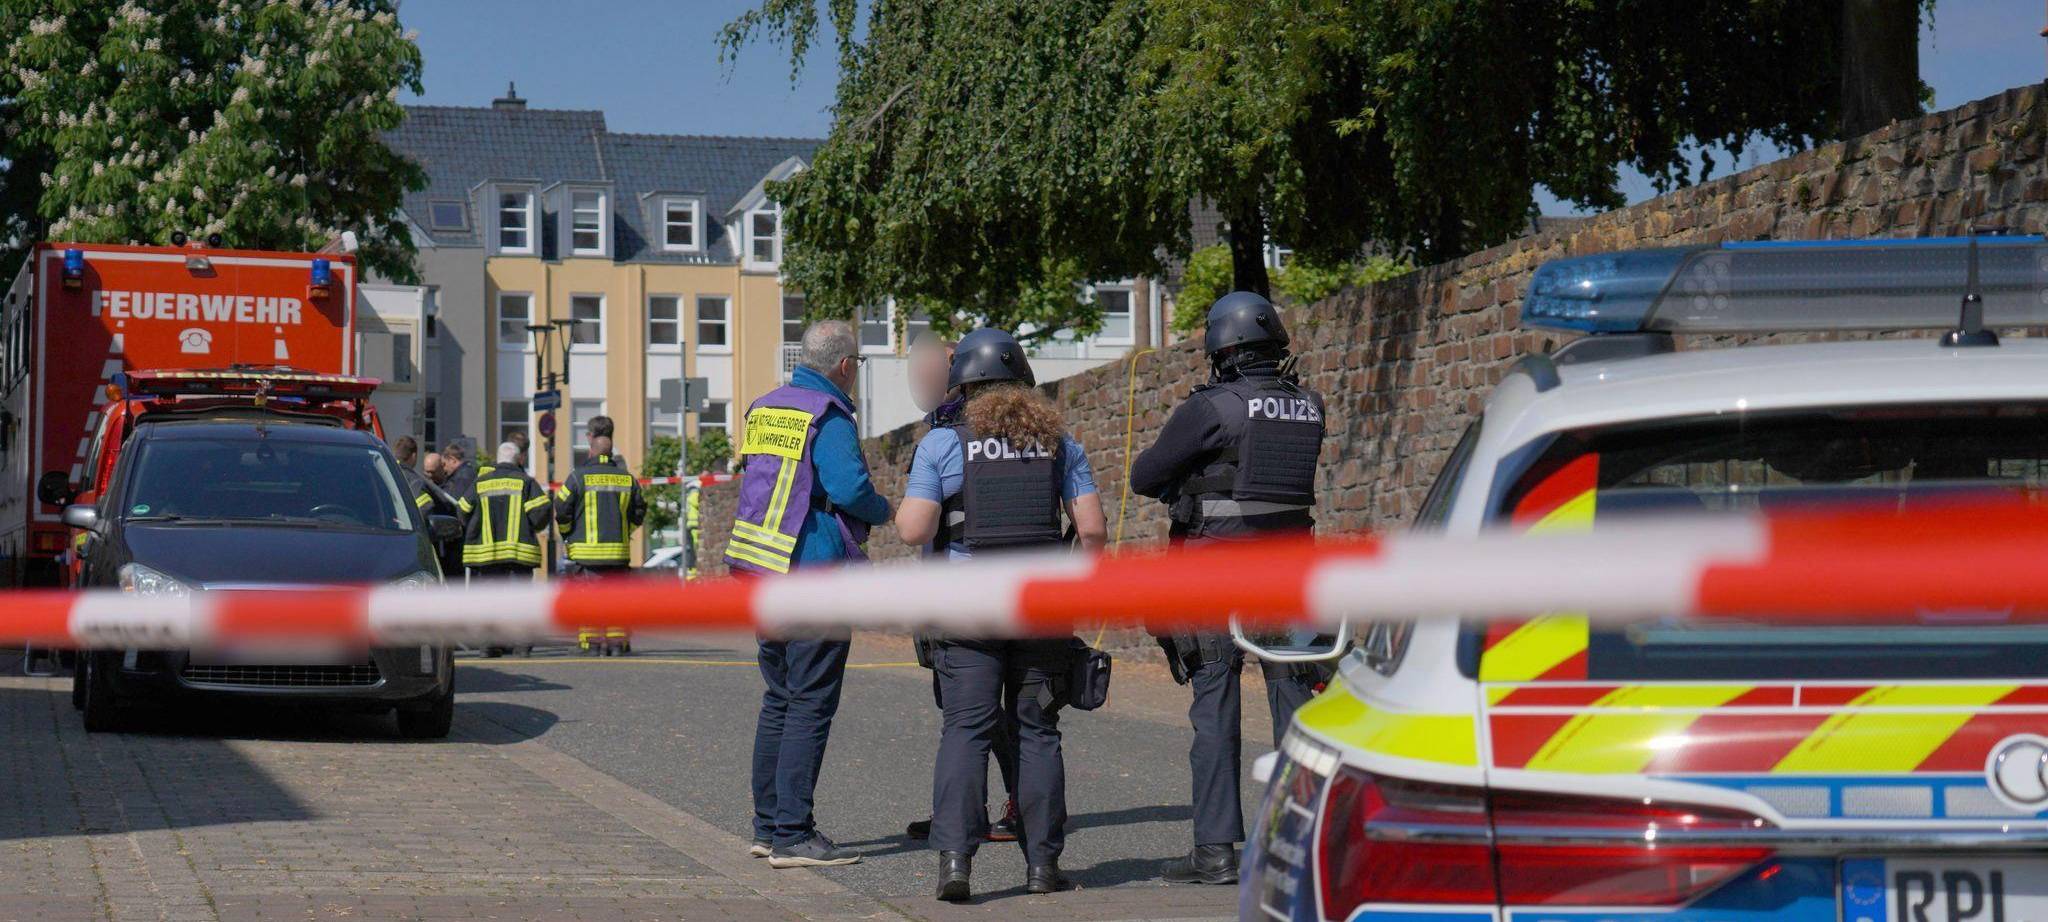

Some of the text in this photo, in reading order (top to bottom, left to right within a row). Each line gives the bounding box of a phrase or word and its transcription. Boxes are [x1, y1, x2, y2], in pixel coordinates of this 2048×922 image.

[91, 290, 302, 324] FEUERWEHR
[1248, 396, 1320, 422] POLIZE
[967, 436, 1056, 461] POLZE
[586, 474, 631, 486] FEUERWEHR
